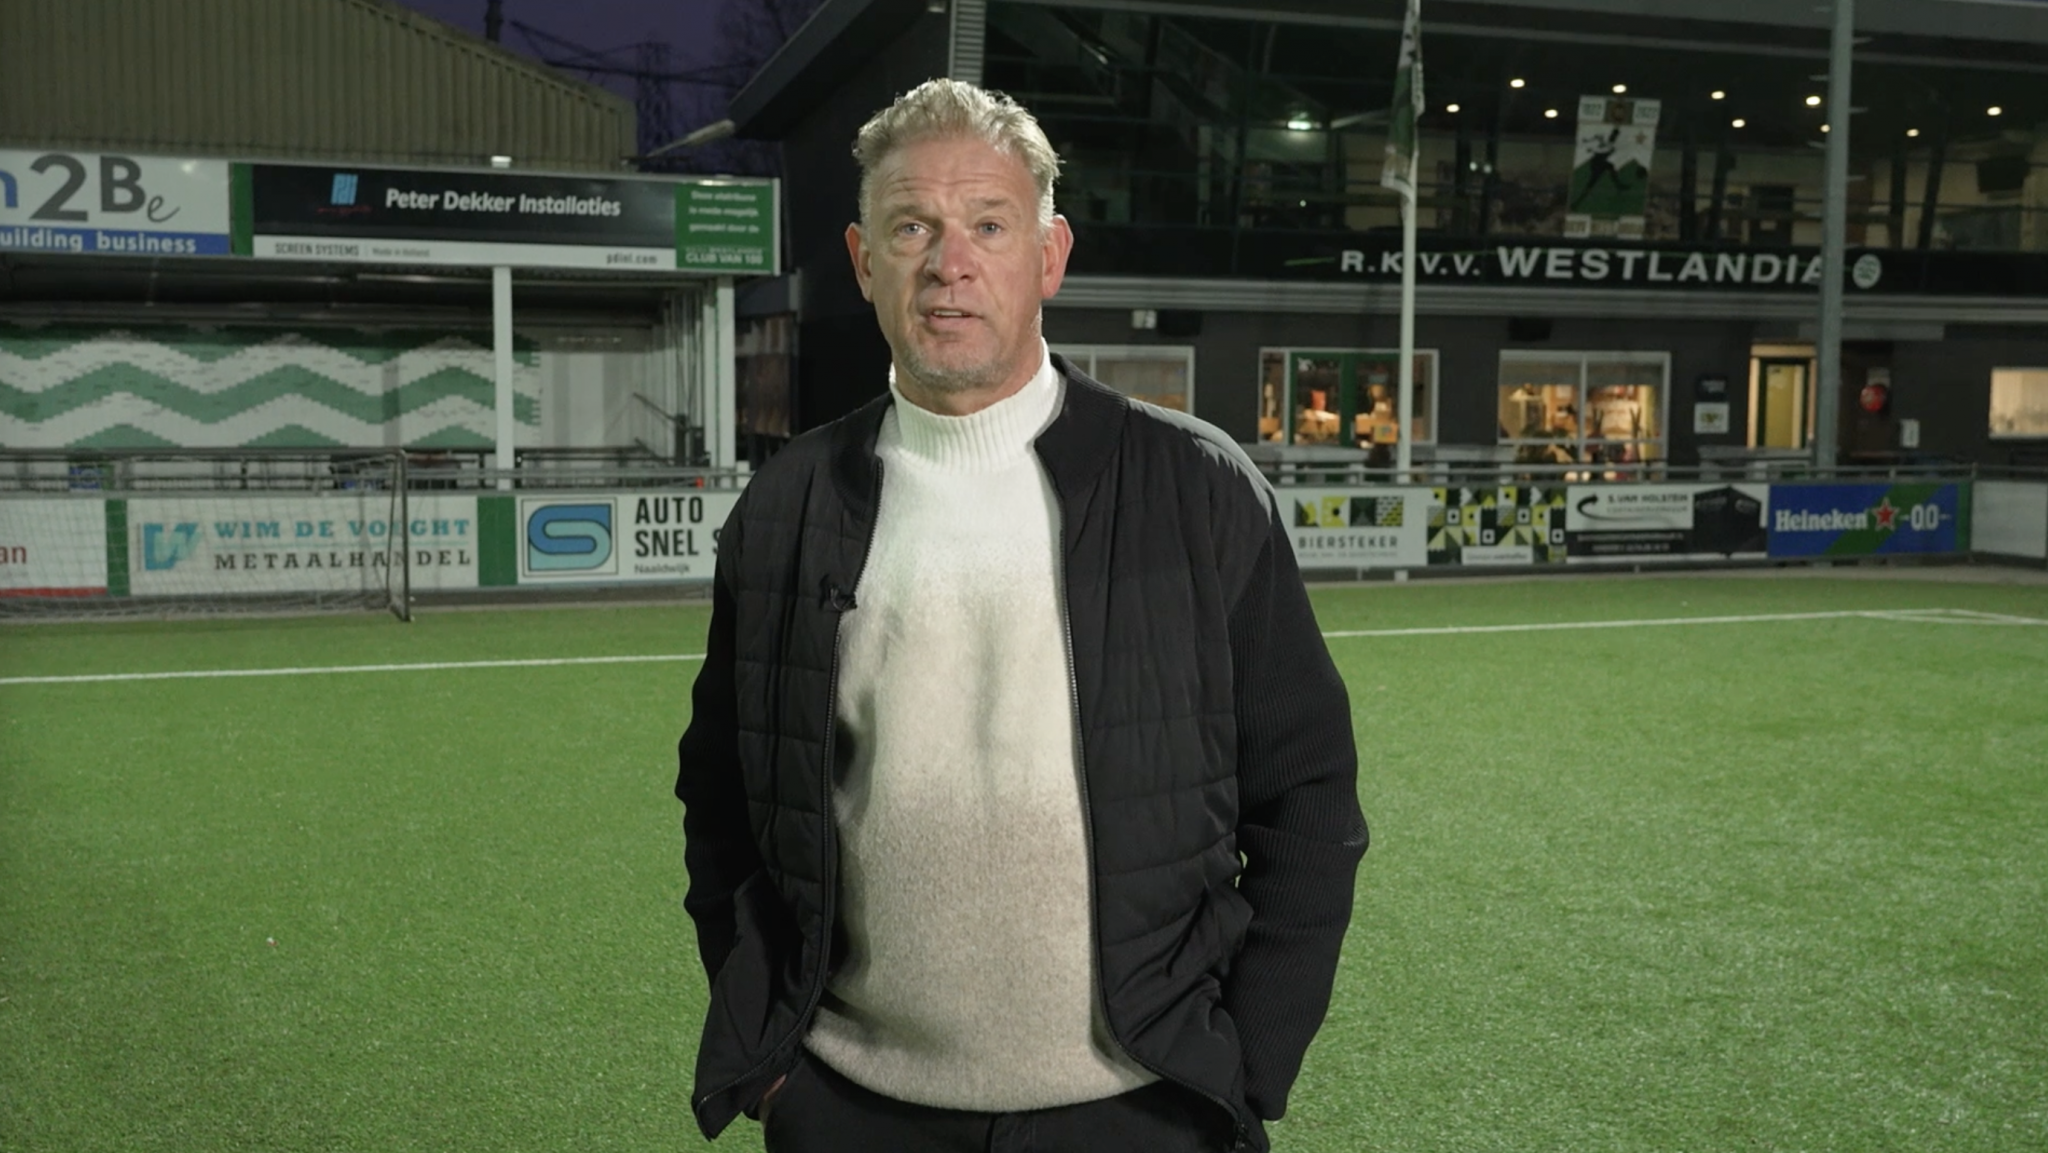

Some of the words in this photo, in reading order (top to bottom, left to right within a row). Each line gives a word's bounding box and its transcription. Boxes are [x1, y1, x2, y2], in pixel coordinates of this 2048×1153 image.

[386, 187, 439, 210] Peter
[443, 190, 515, 213] Dekker
[518, 193, 621, 217] Installaties
[96, 230, 197, 253] business
[275, 242, 313, 255] SCREEN
[315, 243, 360, 257] SYSTEMS
[1495, 246, 1822, 284] WESTLANDIA
[635, 496, 704, 525] AUTO
[1775, 508, 1869, 532] Heineken
[214, 519, 281, 538] WIM
[295, 520, 334, 538] DE
[635, 528, 700, 557] SNEL
[1298, 535, 1398, 549] BIERSTEKER
[214, 549, 471, 571] METAALHANDEL
[634, 562, 691, 576] Naaldwijk
